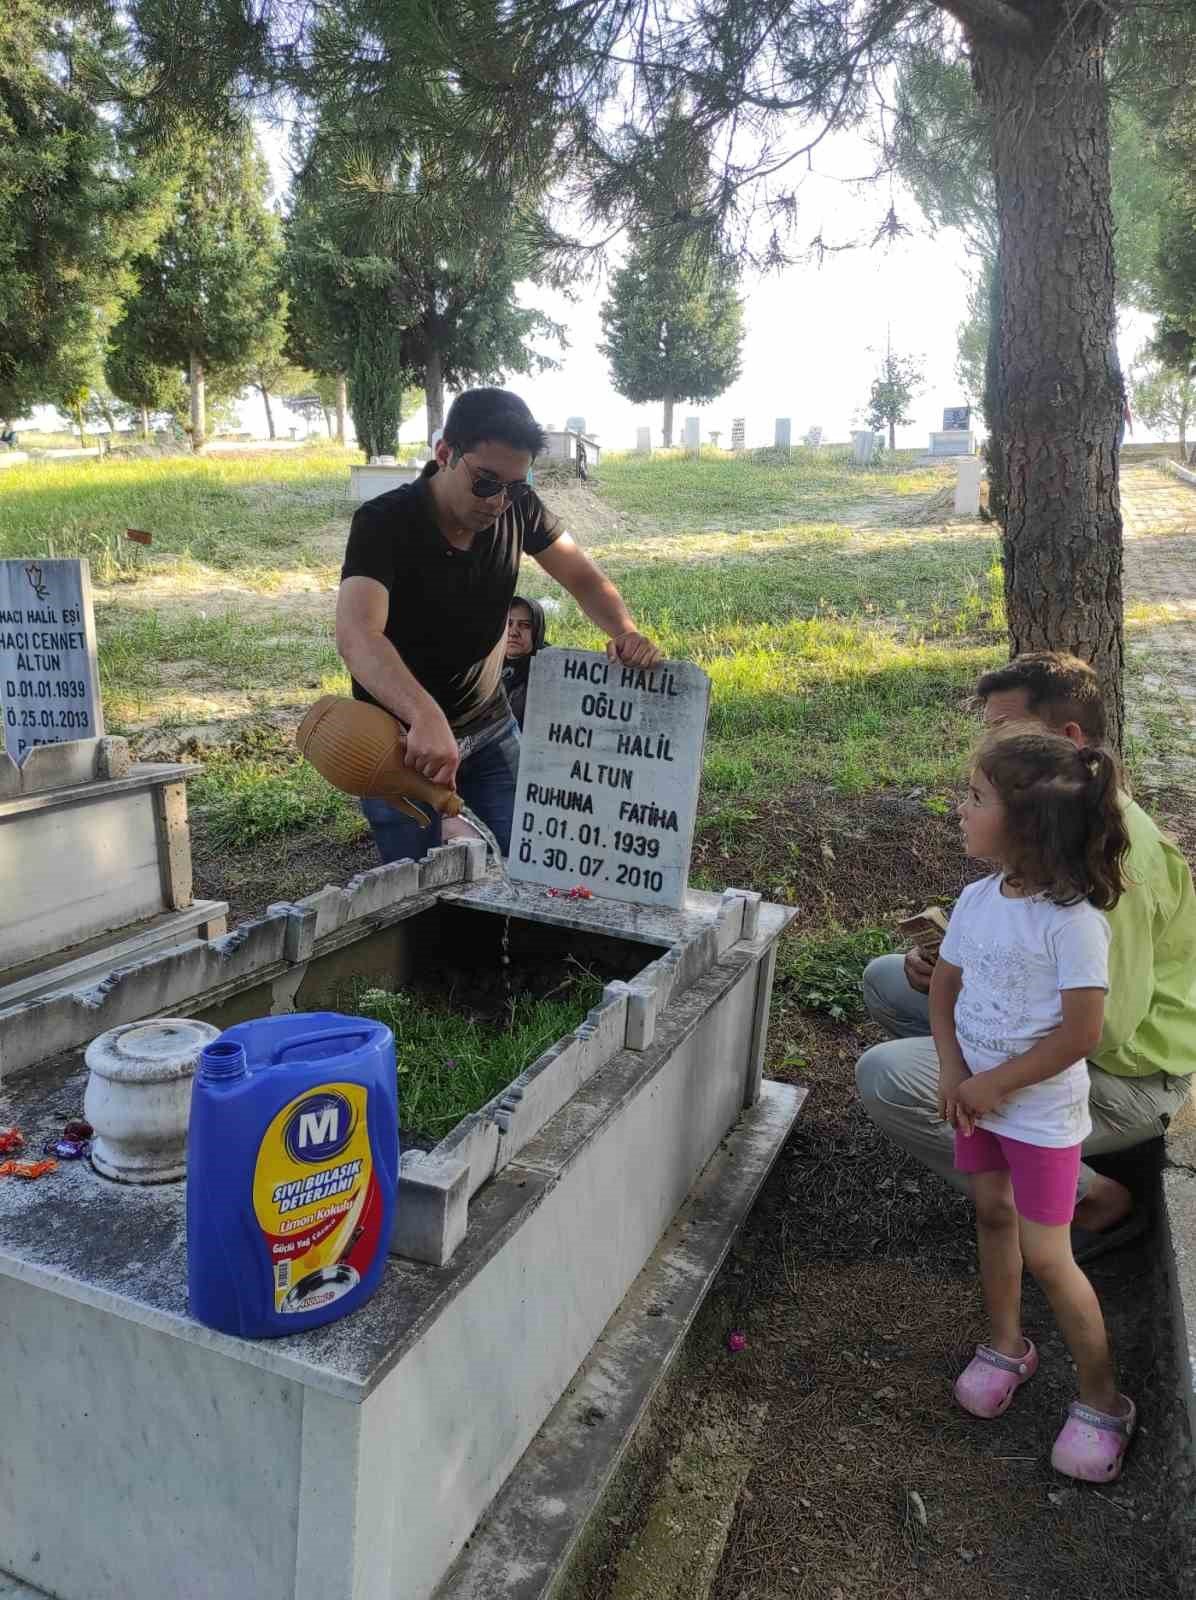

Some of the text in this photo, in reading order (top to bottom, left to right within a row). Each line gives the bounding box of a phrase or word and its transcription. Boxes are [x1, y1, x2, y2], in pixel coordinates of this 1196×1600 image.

[0, 603, 81, 627] HACI HALİL EŞİ
[0, 631, 85, 650] HACI CENNET
[17, 652, 61, 672] ALTUN
[564, 658, 679, 697] HACI HALİL
[6, 680, 86, 698] D.01.01.1939
[7, 706, 89, 728] Ö.25.01.2013
[581, 691, 633, 722] OĞLU
[548, 722, 674, 762] HACI HALİL
[570, 759, 633, 790] ALTUN
[526, 782, 679, 833] RUHUNA FATİHA
[298, 1107, 339, 1149] M
[273, 1180, 302, 1203] SIVI
[279, 1175, 355, 1214] DETERJANI
[280, 1215, 314, 1233] Limon
[316, 1199, 353, 1220] Kokulu
